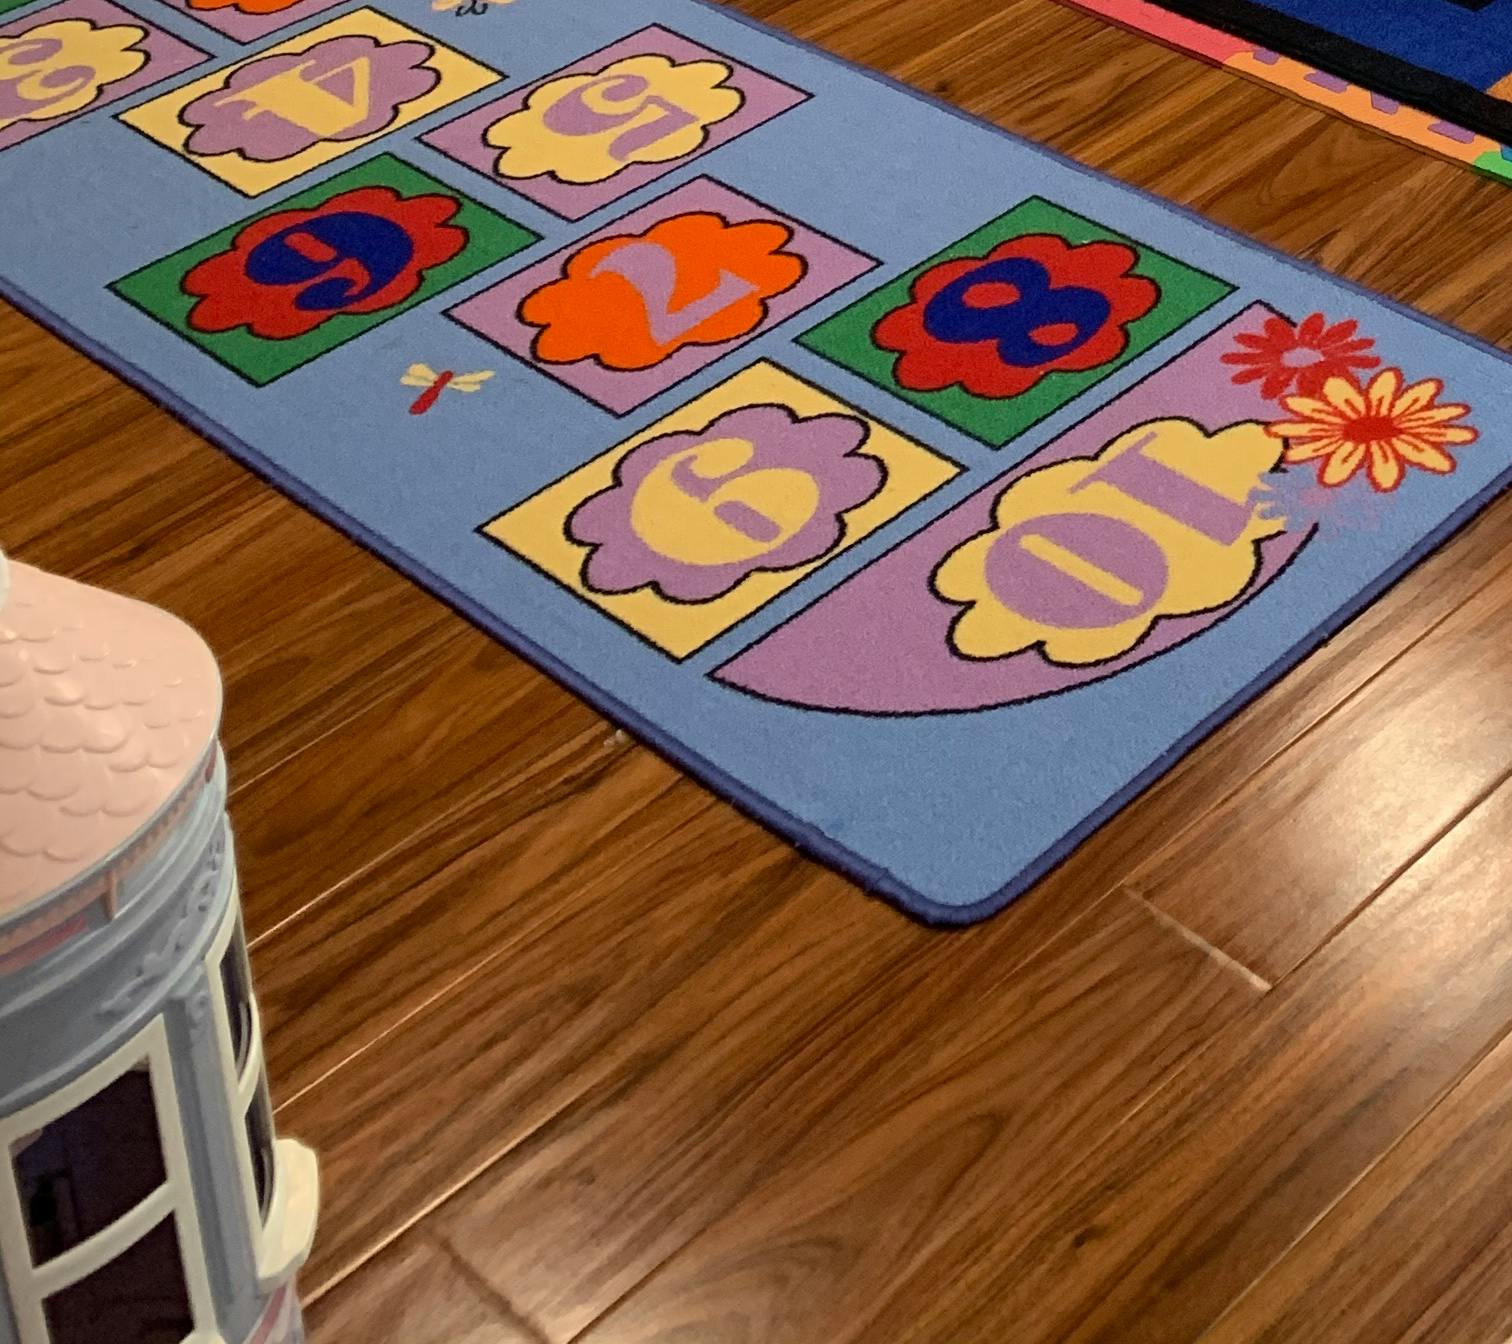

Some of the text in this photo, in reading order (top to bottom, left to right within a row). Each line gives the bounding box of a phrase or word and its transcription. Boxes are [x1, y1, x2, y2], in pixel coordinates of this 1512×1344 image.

[0, 38, 95, 119] 3
[216, 56, 371, 134] 4
[541, 74, 701, 162] 5
[246, 211, 415, 311] 6
[591, 241, 758, 345] 7
[923, 257, 1112, 369] 8
[629, 436, 820, 566] 9
[983, 432, 1267, 629] 10
